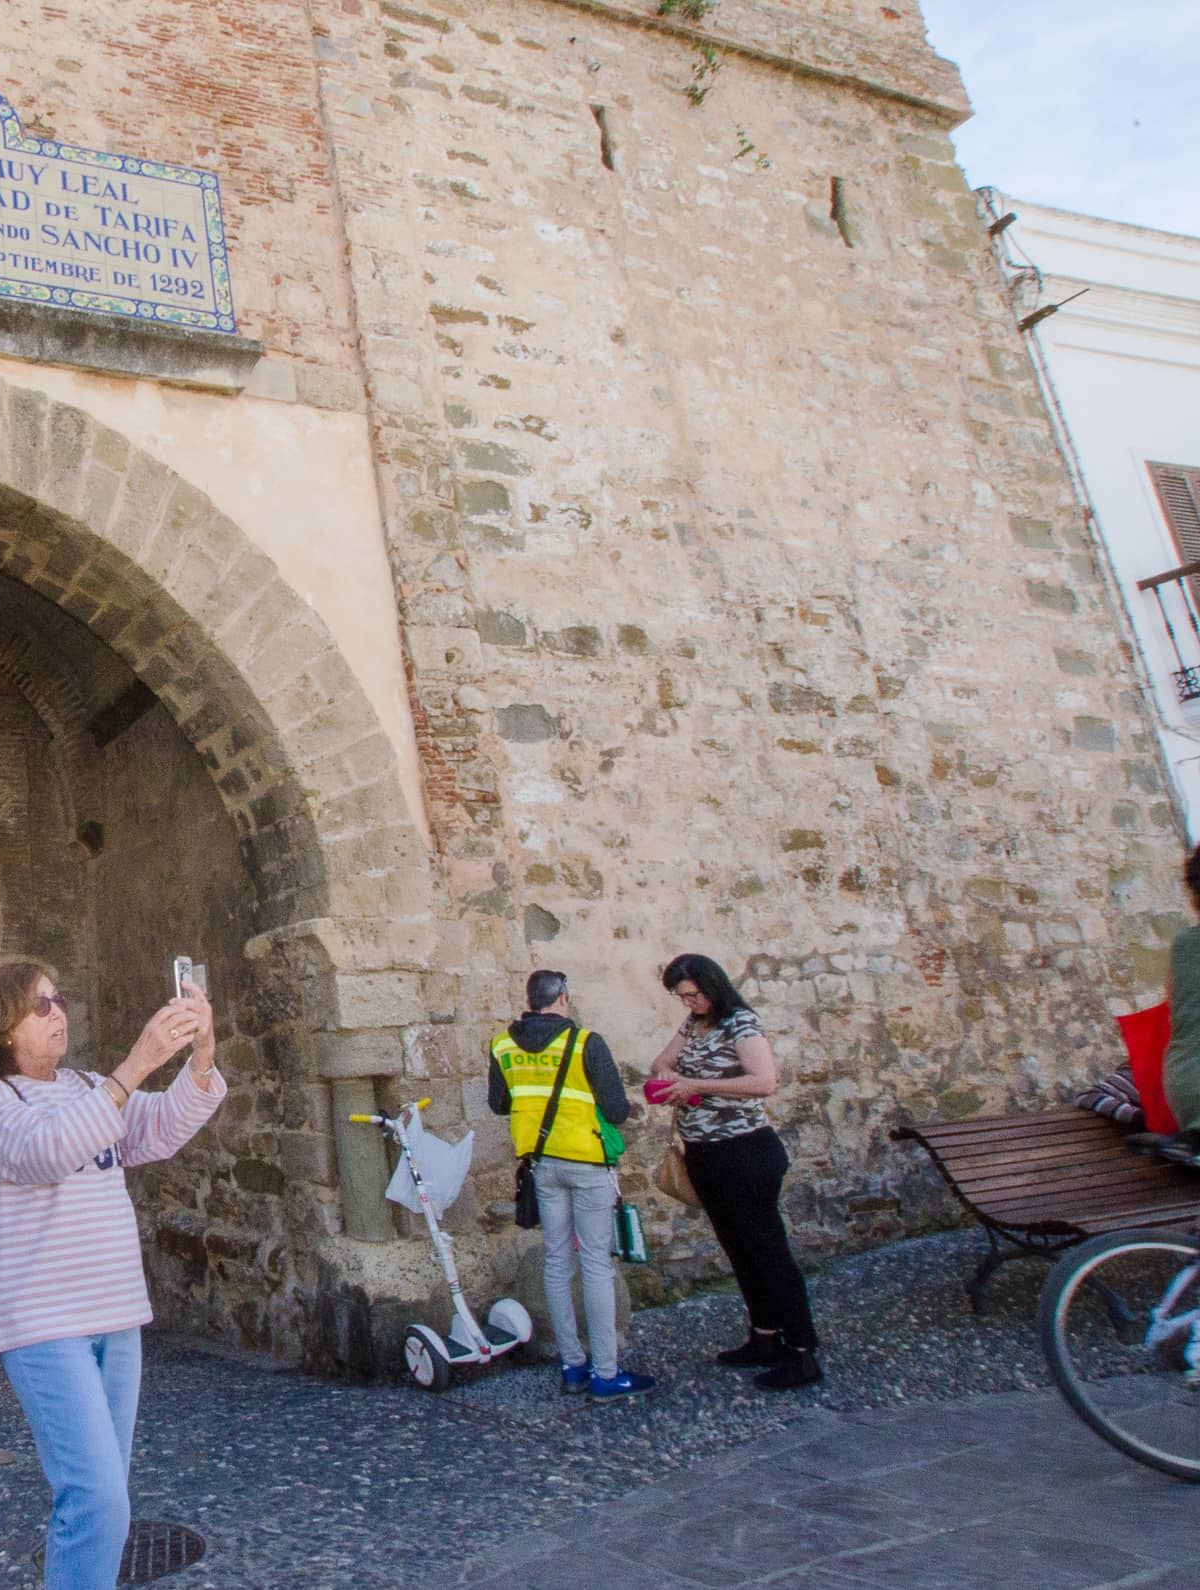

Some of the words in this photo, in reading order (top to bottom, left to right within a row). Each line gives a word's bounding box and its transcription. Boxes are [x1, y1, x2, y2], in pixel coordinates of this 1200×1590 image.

[60, 170, 139, 205] LEAL
[45, 202, 80, 221] DE
[94, 204, 196, 243] TARIFA
[41, 224, 161, 264] SANCHO
[171, 247, 199, 269] IV
[113, 271, 141, 288] DE
[150, 273, 205, 300] 1292
[514, 1054, 560, 1067] ONCE
